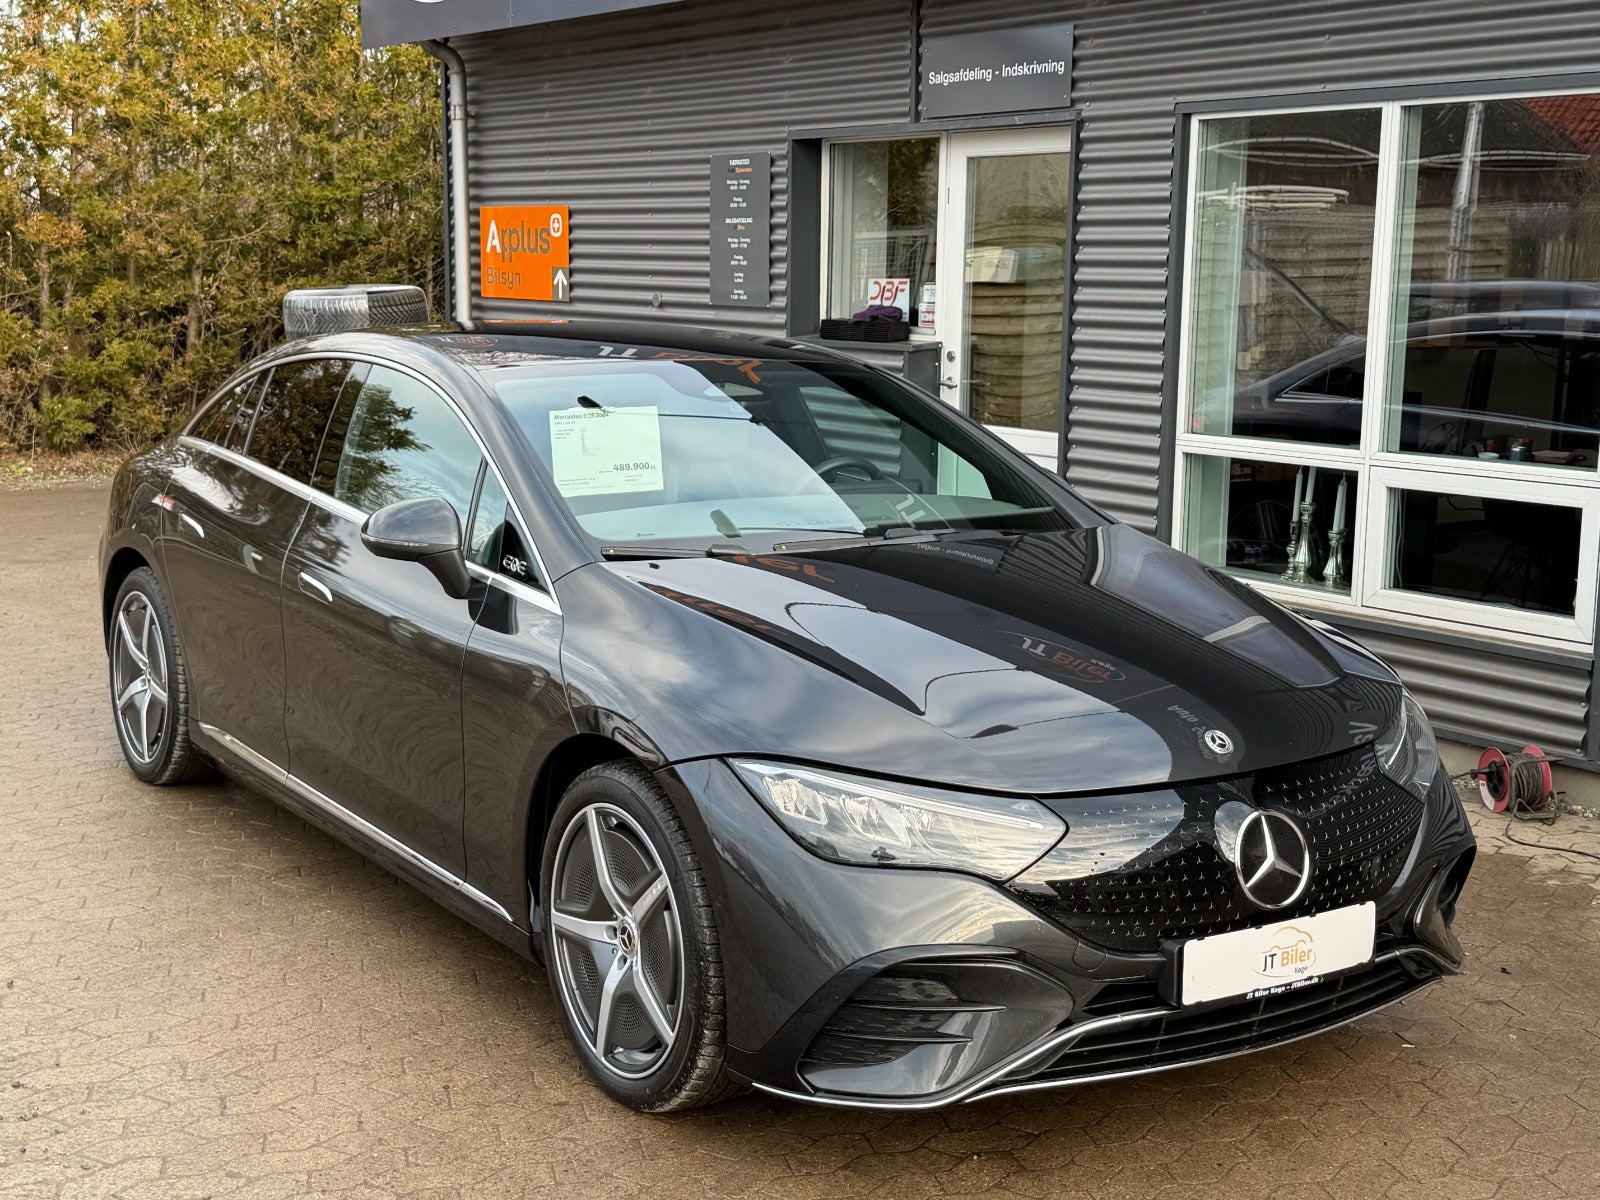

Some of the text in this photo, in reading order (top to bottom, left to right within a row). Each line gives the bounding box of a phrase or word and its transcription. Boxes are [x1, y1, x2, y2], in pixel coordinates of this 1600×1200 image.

[928, 67, 993, 86] Salgsafdeling
[1002, 59, 1065, 76] Indskrivning
[487, 266, 521, 291] Bilsyn
[554, 413, 582, 421] Mercedes
[613, 462, 650, 472] 489.900
[503, 554, 527, 576] EQE
[1263, 949, 1312, 973] JT Biler
